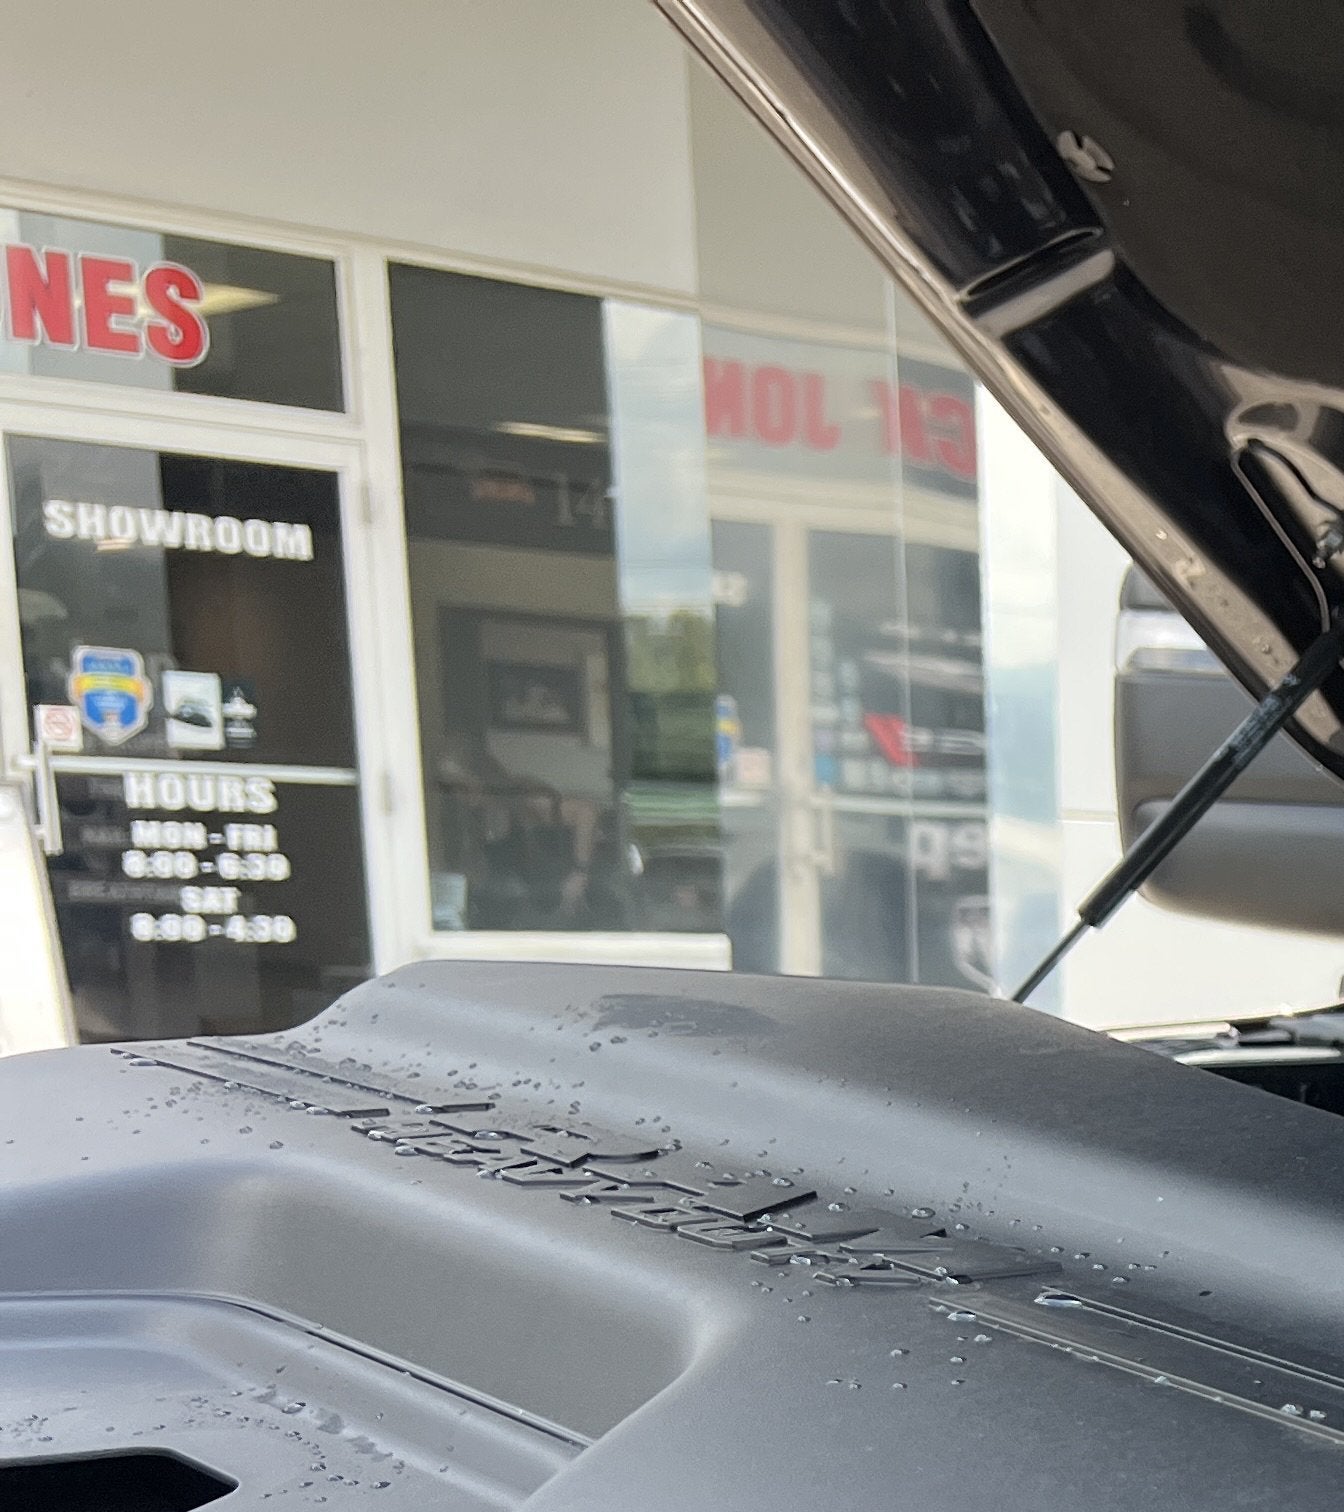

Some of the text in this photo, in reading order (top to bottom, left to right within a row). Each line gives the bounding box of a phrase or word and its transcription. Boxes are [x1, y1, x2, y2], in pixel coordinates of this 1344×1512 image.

[3, 244, 209, 366] NES
[44, 500, 314, 560] SHOWROOM
[123, 773, 279, 814] HOURS
[180, 886, 241, 914] SAT
